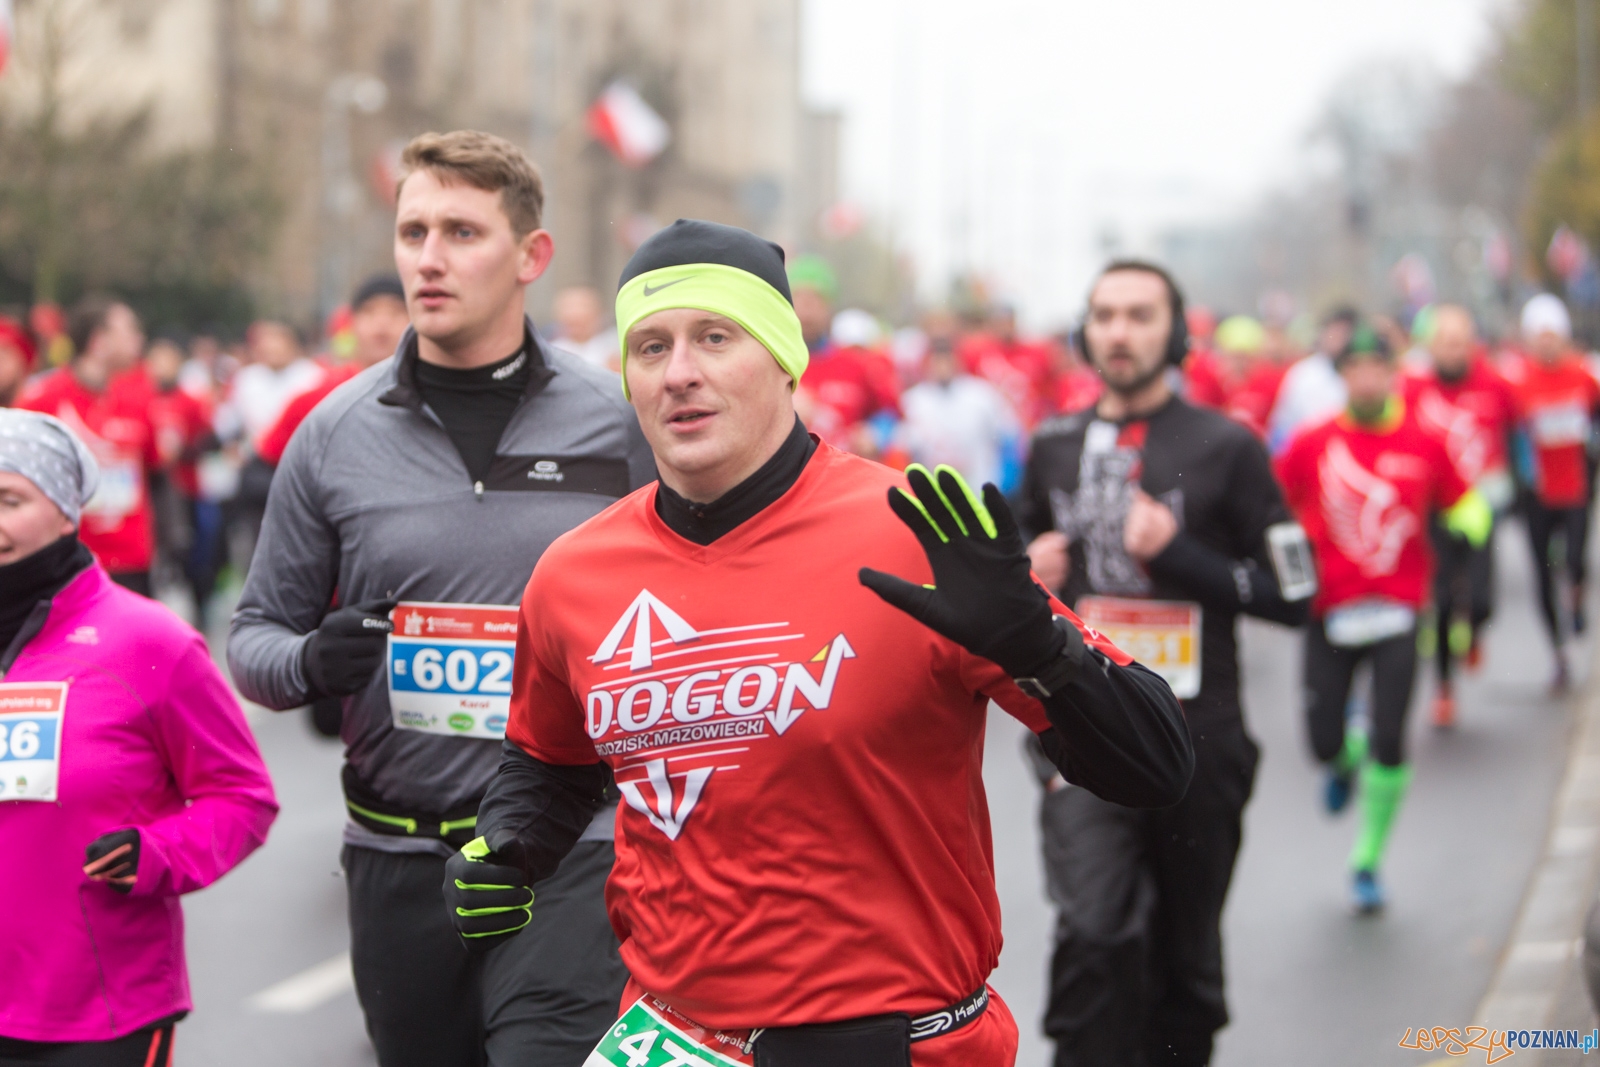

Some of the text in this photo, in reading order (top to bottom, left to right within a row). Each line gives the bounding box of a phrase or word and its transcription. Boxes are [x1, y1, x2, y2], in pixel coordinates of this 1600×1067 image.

[412, 648, 513, 692] 602
[587, 632, 857, 738] DOGON
[613, 1023, 627, 1038] C
